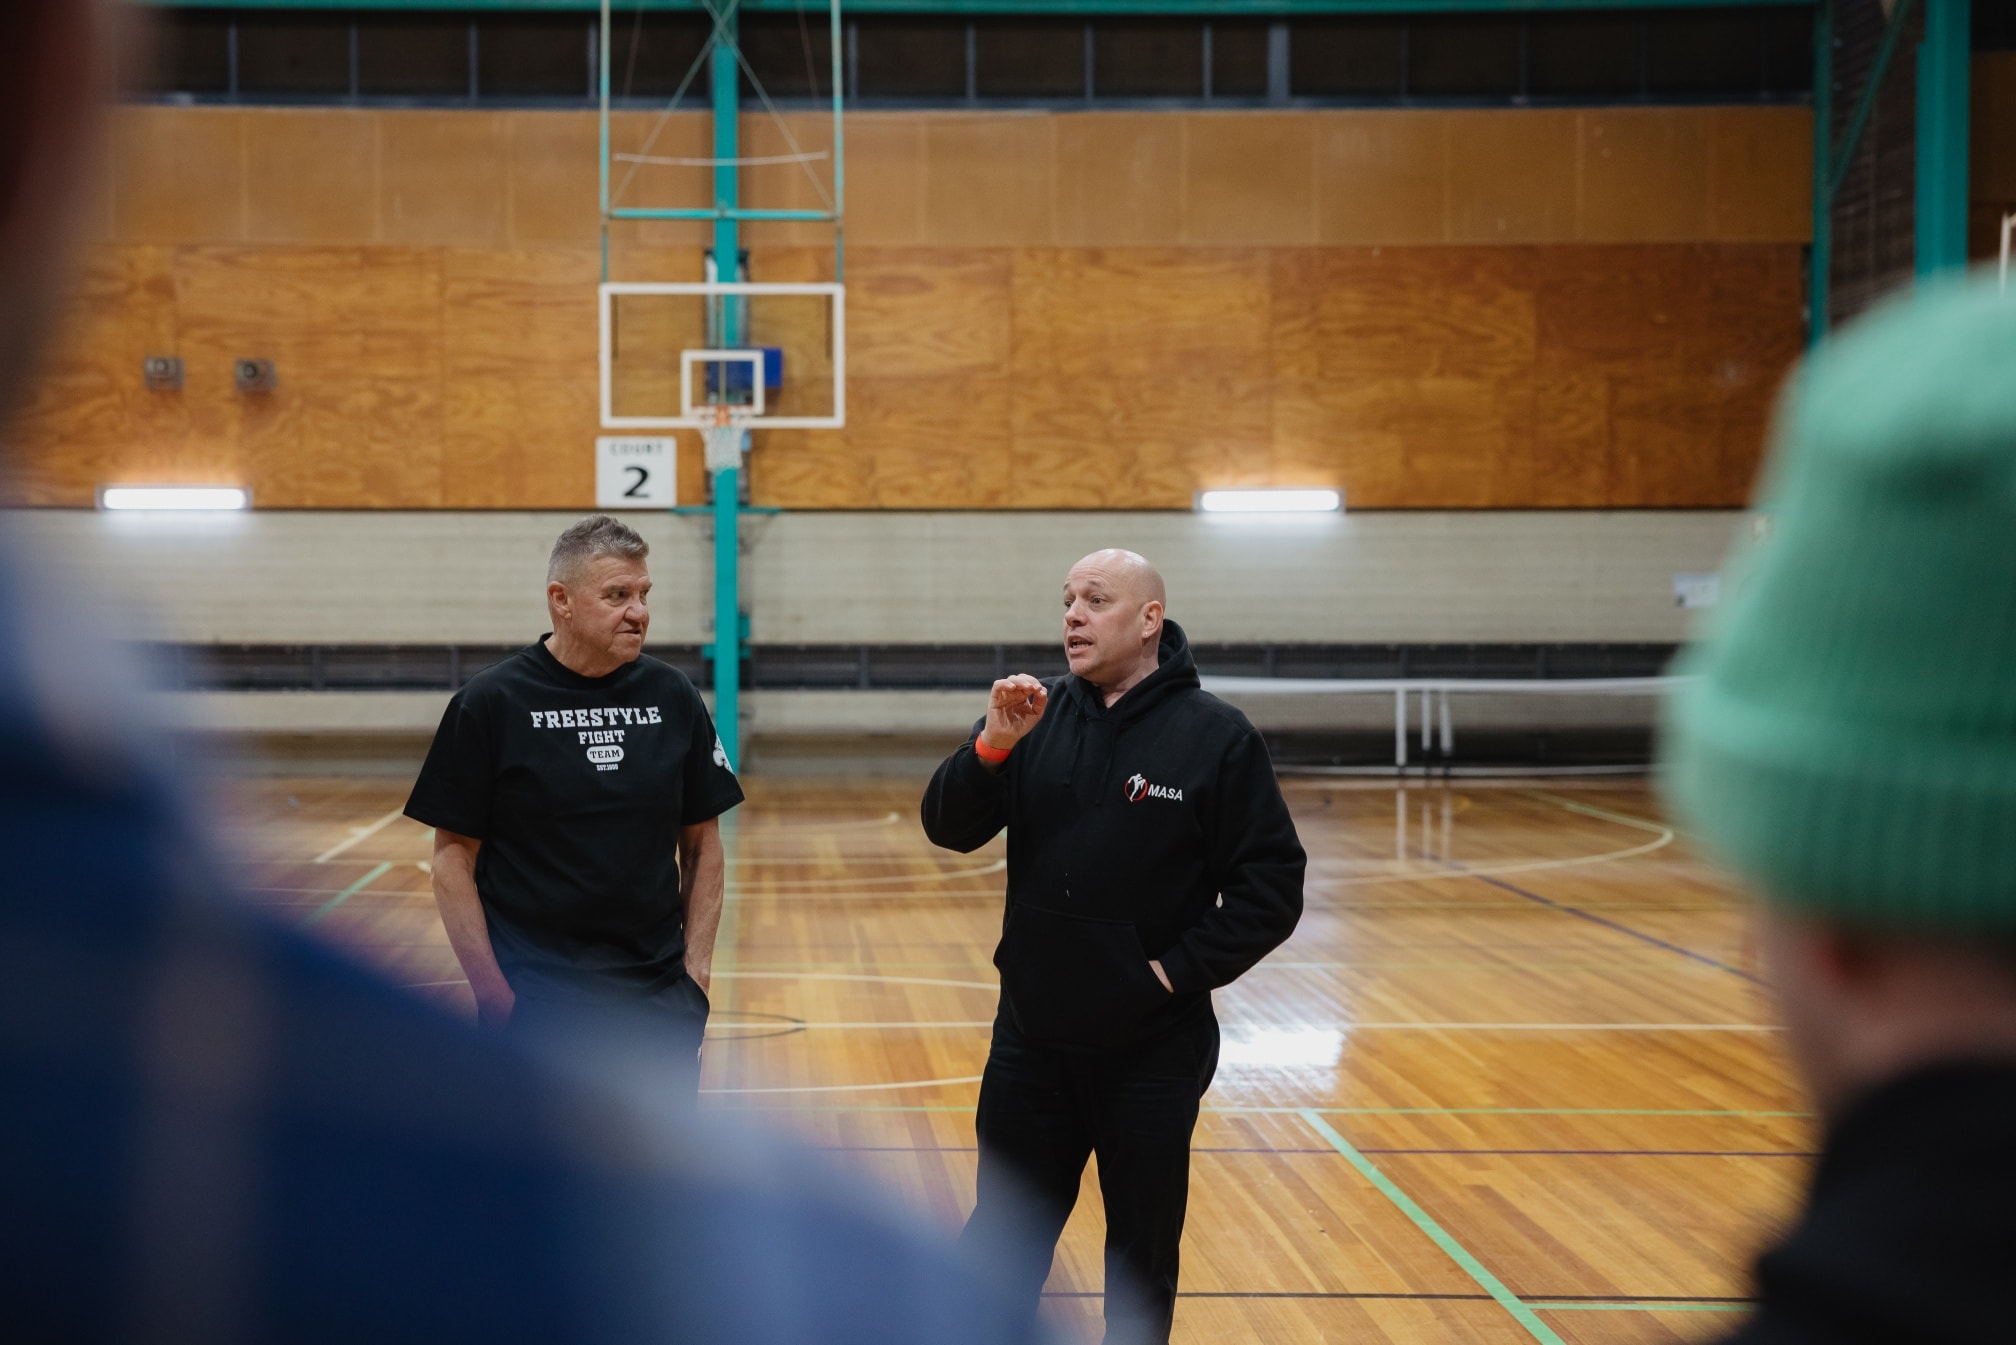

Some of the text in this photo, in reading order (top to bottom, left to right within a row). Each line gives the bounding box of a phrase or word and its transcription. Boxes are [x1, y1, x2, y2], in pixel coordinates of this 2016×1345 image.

[623, 465, 649, 498] 2
[530, 706, 662, 729] FREESTYLE
[578, 730, 625, 745] FIGHT
[589, 749, 621, 759] TEAM
[1147, 783, 1183, 802] MASA
